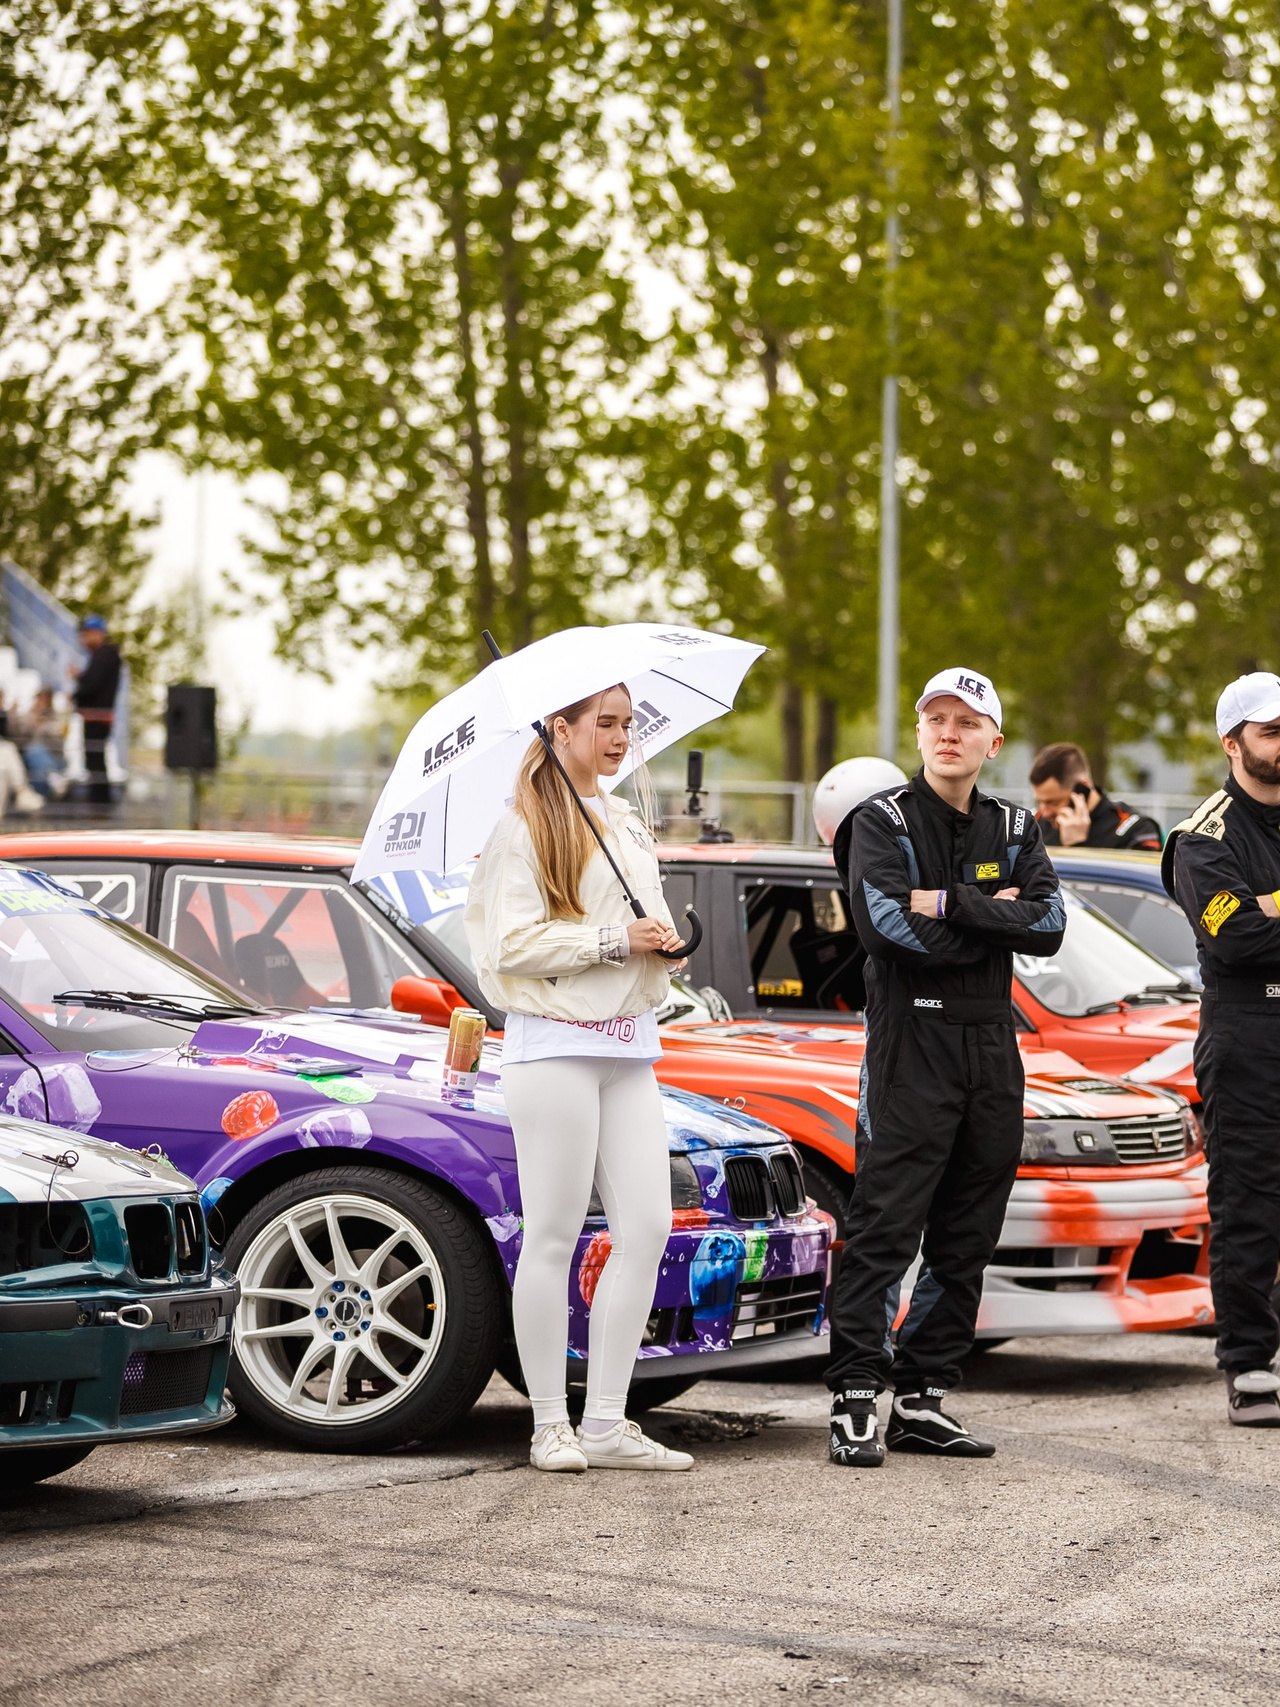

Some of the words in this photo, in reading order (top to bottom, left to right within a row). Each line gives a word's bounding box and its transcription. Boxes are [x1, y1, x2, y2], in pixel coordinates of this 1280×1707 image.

[956, 685, 983, 701] МОХИТО
[959, 675, 986, 697] ICE
[424, 715, 475, 768] ICE
[422, 735, 475, 777] МОХИТО
[1205, 820, 1219, 834] OMP
[978, 864, 998, 874] ASP
[1203, 892, 1230, 930] ASP
[914, 998, 943, 1008] sparc
[845, 1390, 875, 1399] sparco
